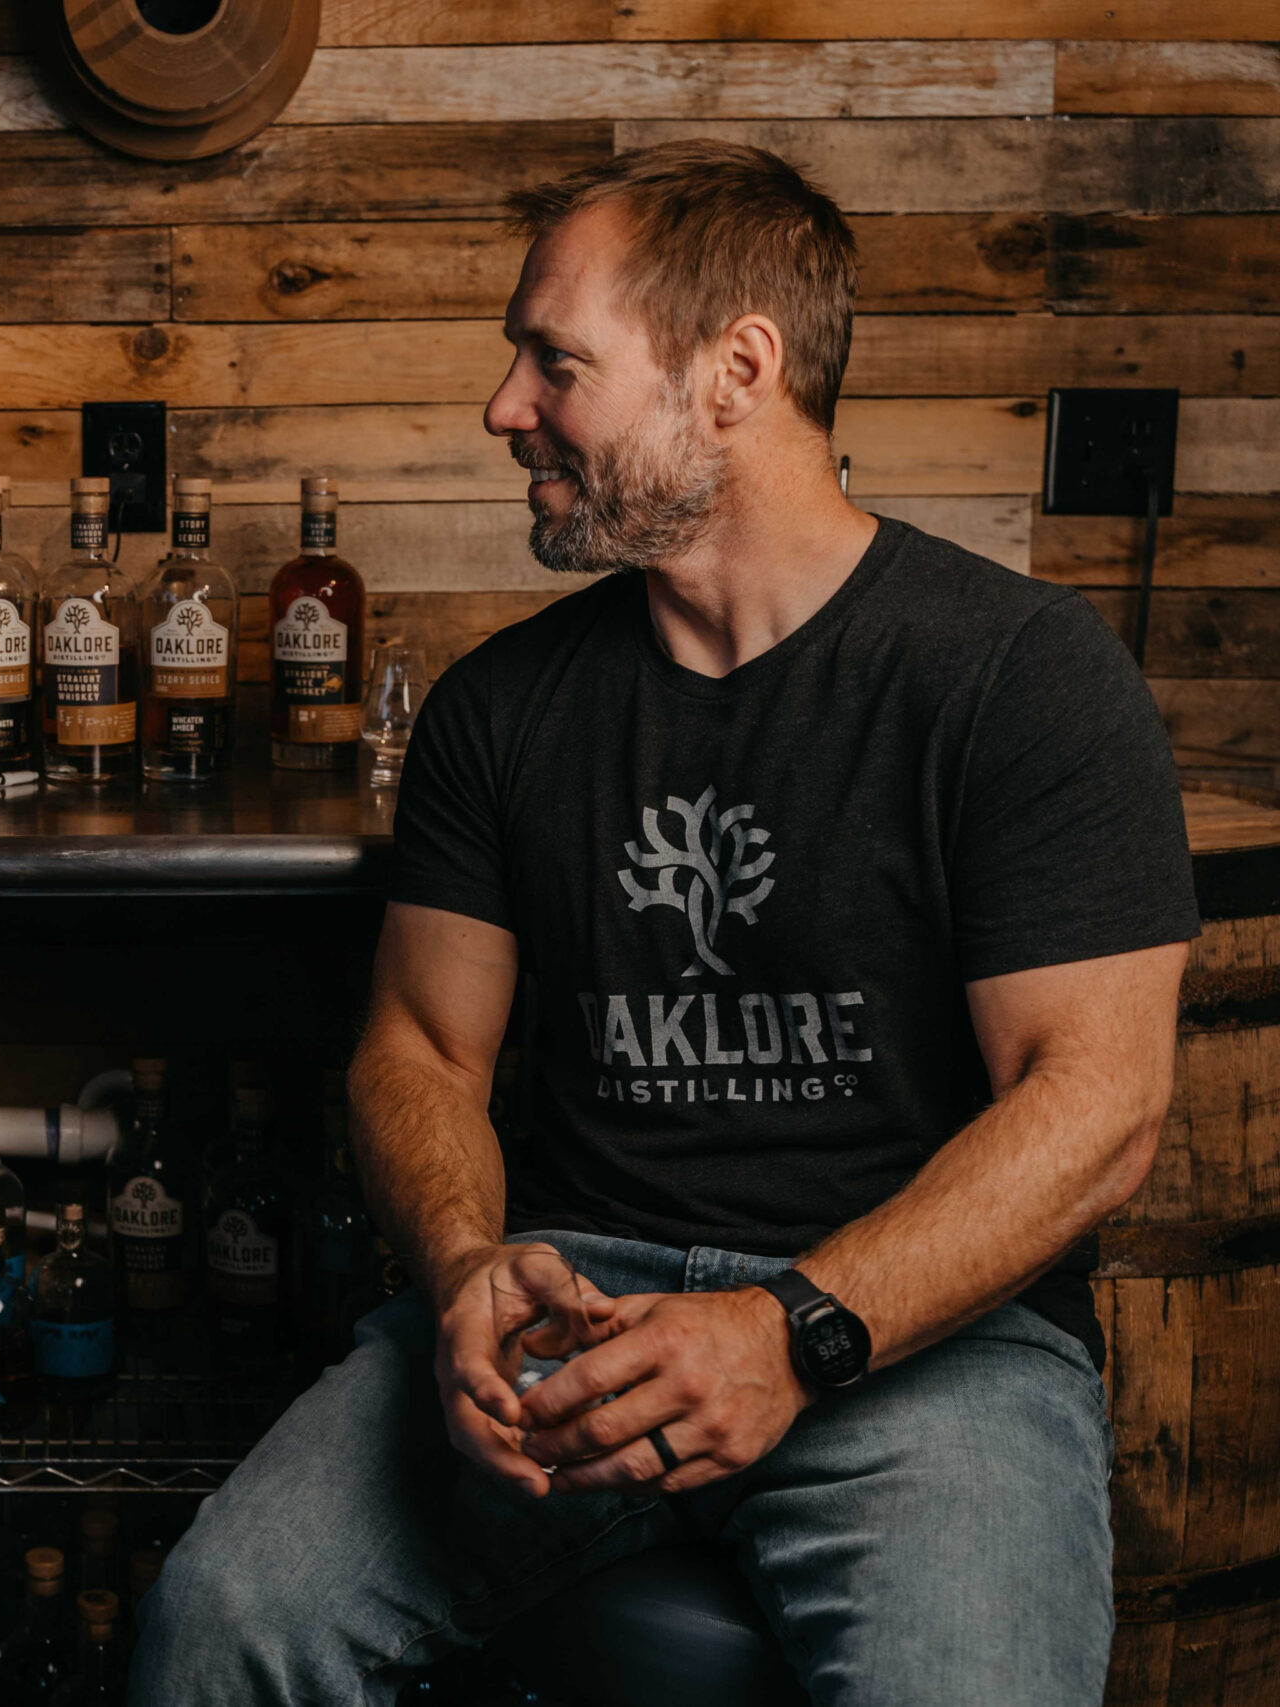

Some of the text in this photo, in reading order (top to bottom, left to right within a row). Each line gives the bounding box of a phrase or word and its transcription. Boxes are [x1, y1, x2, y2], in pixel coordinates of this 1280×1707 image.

[179, 520, 206, 529] STORY
[47, 635, 113, 653] OAKLORE
[155, 637, 223, 655] OAKLORE
[277, 631, 341, 650] OAKLORE
[56, 674, 101, 684] STRAIGHT
[58, 683, 100, 693] BOURBON
[157, 674, 221, 685] STORY SERIES
[58, 692, 101, 702] WHISKEY
[576, 991, 873, 1068] OAKLORE
[595, 1074, 826, 1104] DISTILLING
[115, 1207, 179, 1226] OAKLORE
